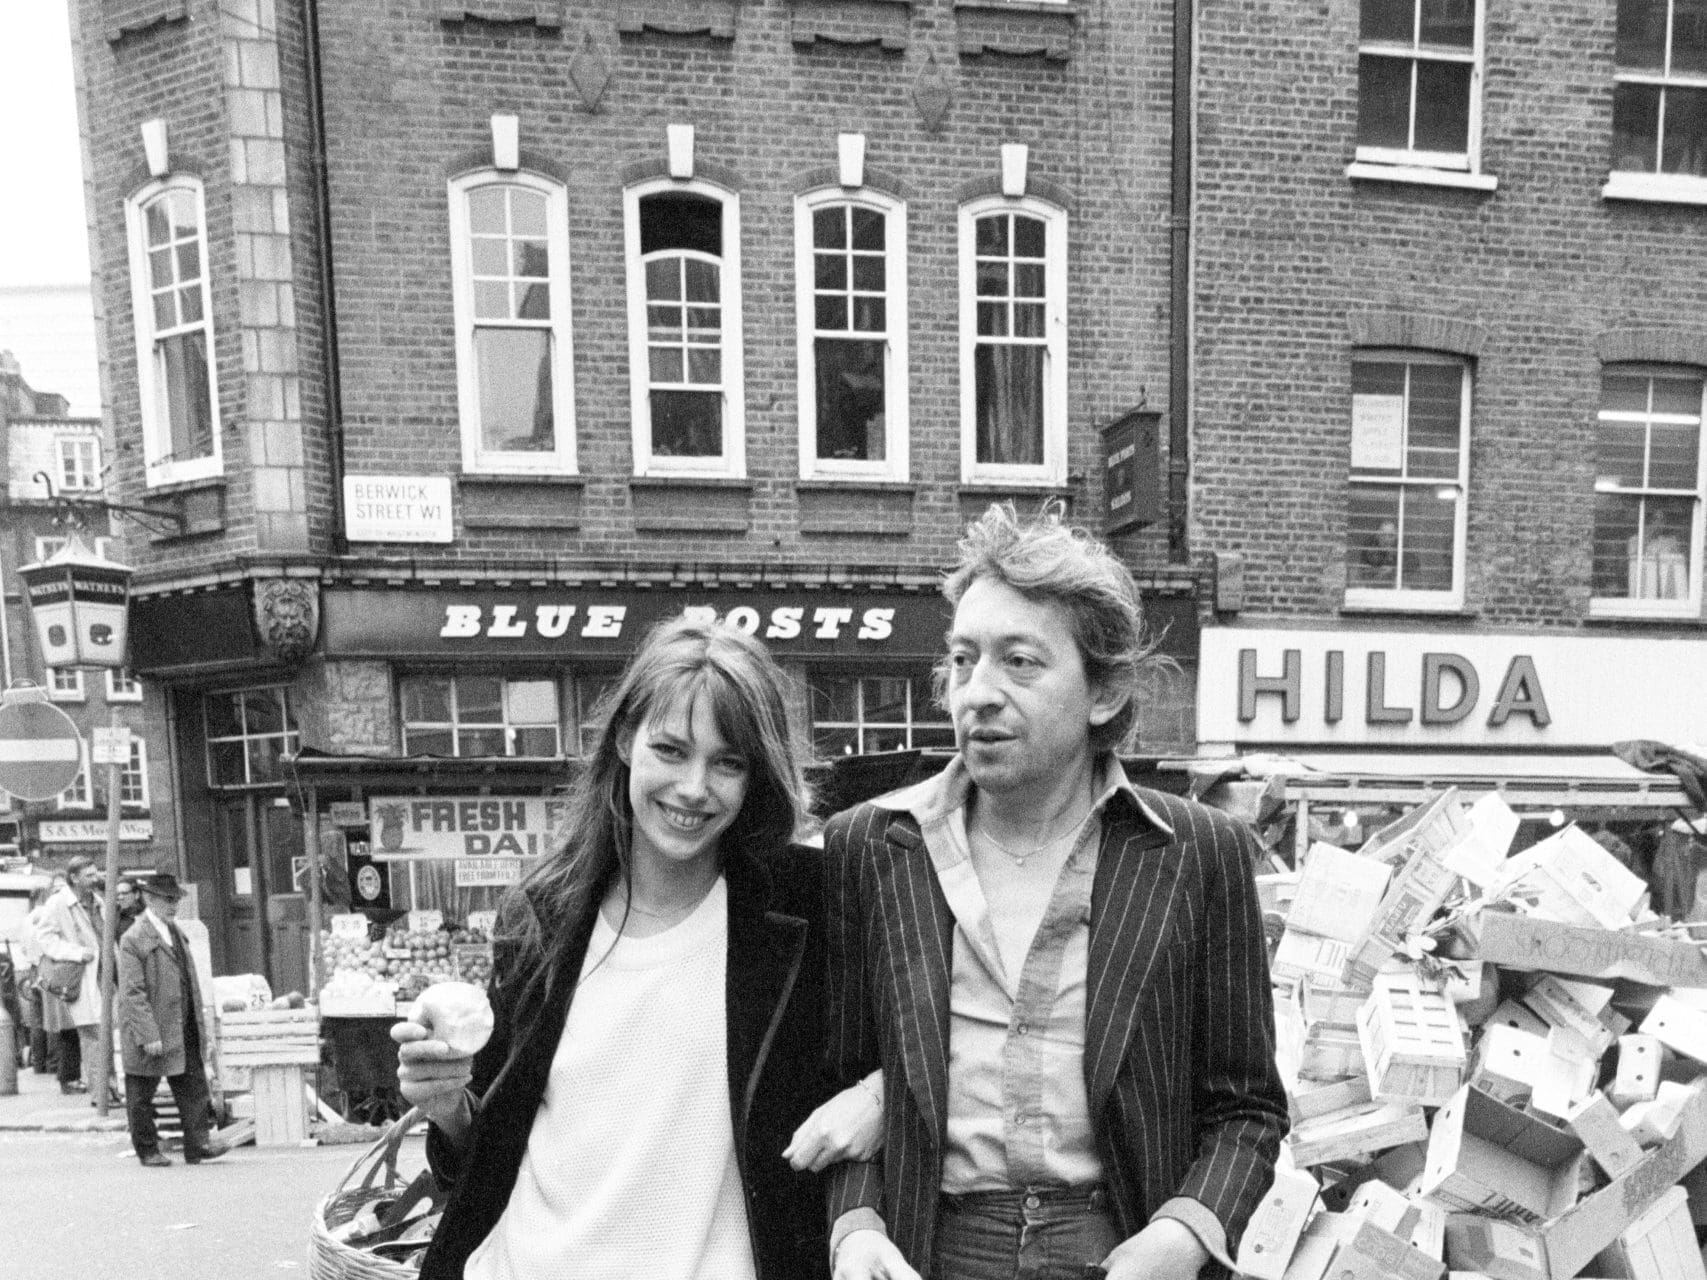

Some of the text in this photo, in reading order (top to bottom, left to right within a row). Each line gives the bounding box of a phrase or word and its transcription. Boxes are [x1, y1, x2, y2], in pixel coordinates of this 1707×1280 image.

[355, 484, 429, 500] BERWICK
[357, 504, 442, 520] STREET W1
[73, 581, 125, 595] WATNEYS
[440, 605, 627, 638] BLUE
[1237, 648, 1552, 732] HILDA
[411, 801, 527, 832] FRESH
